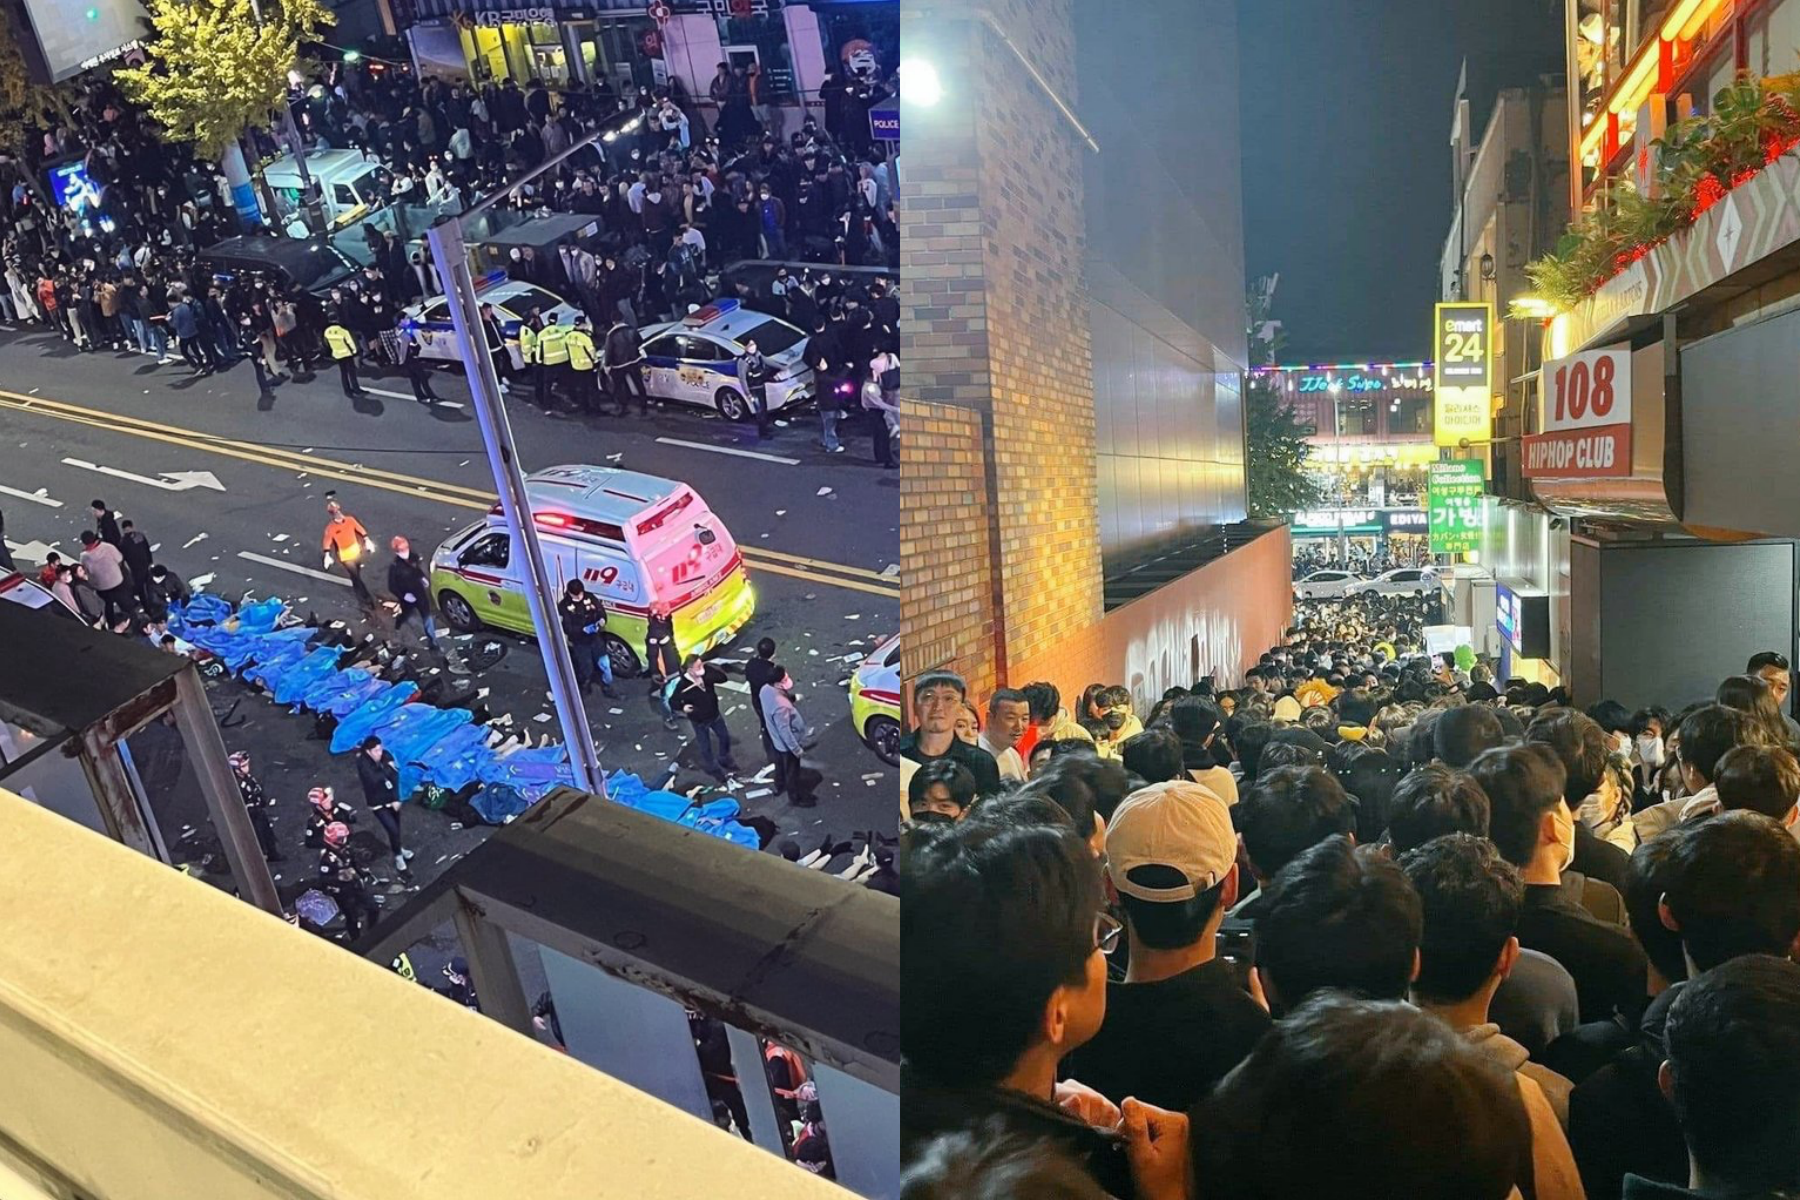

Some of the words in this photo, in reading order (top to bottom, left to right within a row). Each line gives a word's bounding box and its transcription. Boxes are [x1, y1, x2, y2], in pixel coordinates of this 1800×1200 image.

[873, 120, 899, 129] POLICE
[1444, 319, 1483, 332] emart
[1444, 333, 1484, 363] 24
[1555, 355, 1615, 422] 108
[1528, 440, 1575, 469] HIPHOP
[1576, 436, 1615, 468] CLUB
[1390, 514, 1428, 525] EDIYA
[672, 543, 702, 583] 119
[583, 566, 619, 585] 119
